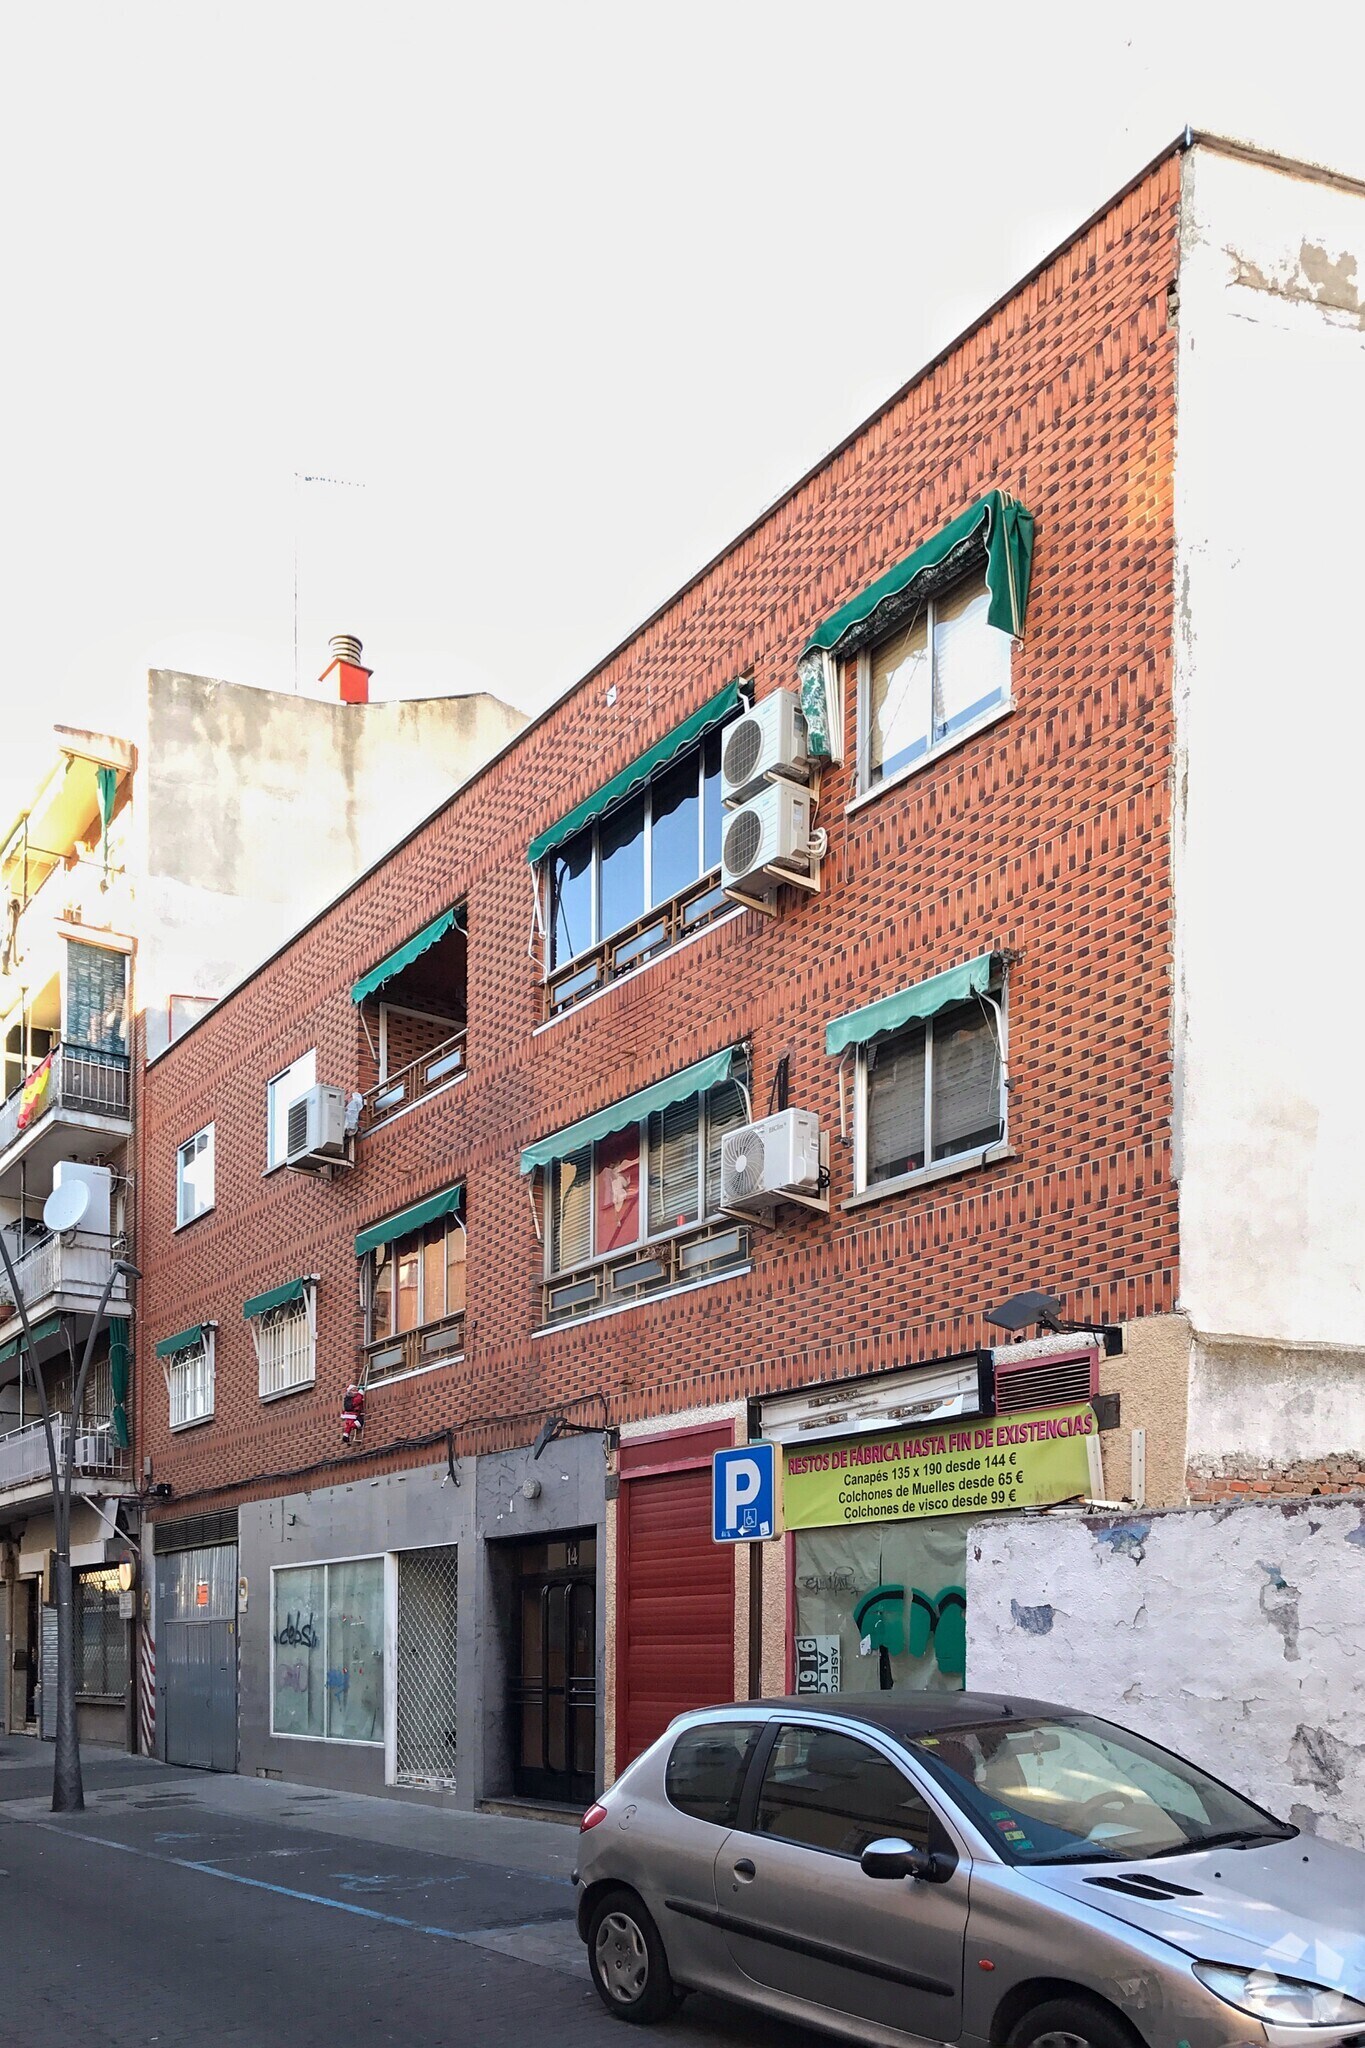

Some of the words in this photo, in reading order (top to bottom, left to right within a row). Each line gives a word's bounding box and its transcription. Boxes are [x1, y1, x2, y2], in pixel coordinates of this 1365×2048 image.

[788, 1454, 829, 1475] RESTOS
[832, 1450, 848, 1470] DE
[850, 1442, 901, 1466] FÁBRICA
[904, 1436, 947, 1459] HASTA
[949, 1432, 971, 1453] FIN
[974, 1428, 993, 1449] DE
[997, 1413, 1093, 1446] EXISTENCIAS
[844, 1470, 888, 1486] Canapés
[892, 1467, 910, 1480] 135
[913, 1467, 920, 1477] x
[923, 1462, 942, 1476] 190
[945, 1458, 981, 1473] desde
[984, 1453, 1006, 1469] 144
[1009, 1452, 1017, 1465] €
[725, 1458, 761, 1529] P
[838, 1488, 893, 1504] Colchones
[896, 1485, 909, 1497] de
[912, 1480, 955, 1496] Muelles
[958, 1475, 994, 1490] desde
[998, 1472, 1013, 1486] 65
[1016, 1470, 1024, 1483] €
[844, 1503, 899, 1519] Colchones
[902, 1500, 915, 1512] de
[918, 1497, 949, 1511] visco
[952, 1492, 988, 1508] desde
[991, 1490, 1005, 1504] 99
[1008, 1488, 1016, 1502] €
[567, 1546, 578, 1566] 14
[798, 1640, 817, 1661] 91
